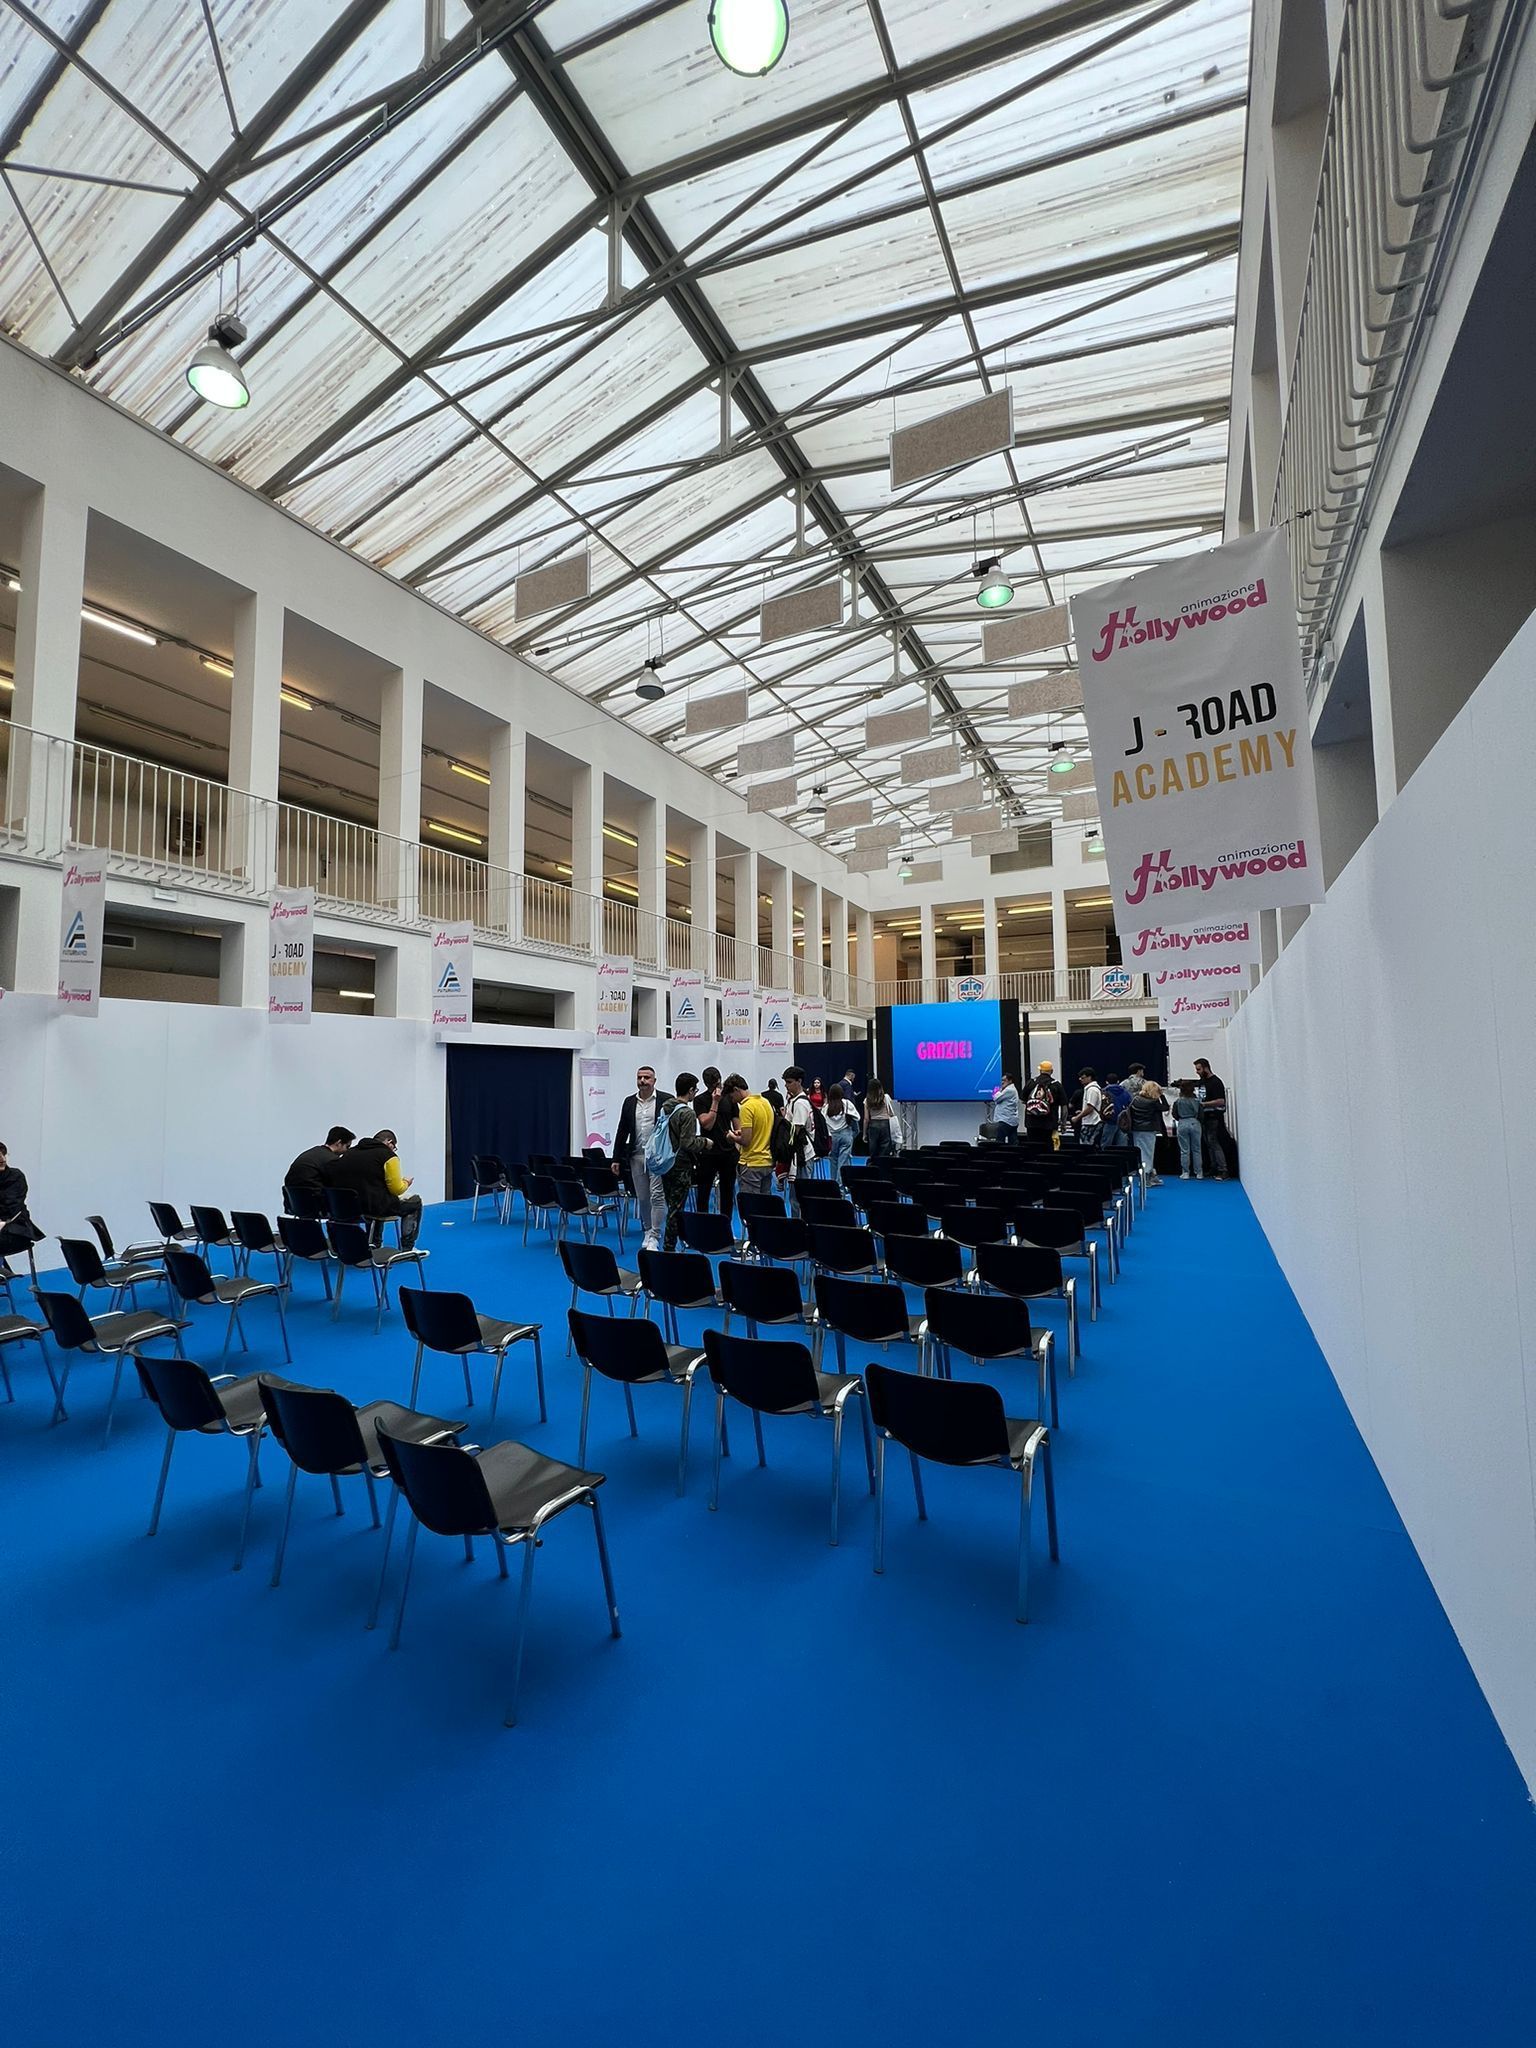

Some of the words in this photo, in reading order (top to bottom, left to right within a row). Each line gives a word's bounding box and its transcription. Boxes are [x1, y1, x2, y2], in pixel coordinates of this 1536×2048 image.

[1181, 583, 1255, 613] animazione
[1092, 578, 1268, 661] Hollywood
[1112, 728, 1297, 808] ACADEMY
[1217, 841, 1296, 863] animazione
[1125, 840, 1307, 905] Hollywood
[270, 901, 308, 920] Hollywood
[1132, 922, 1250, 956] Hollywood
[1193, 923, 1243, 935] animazione
[1171, 997, 1230, 1015] Hollywood
[916, 1040, 973, 1060] GRAZIE!
